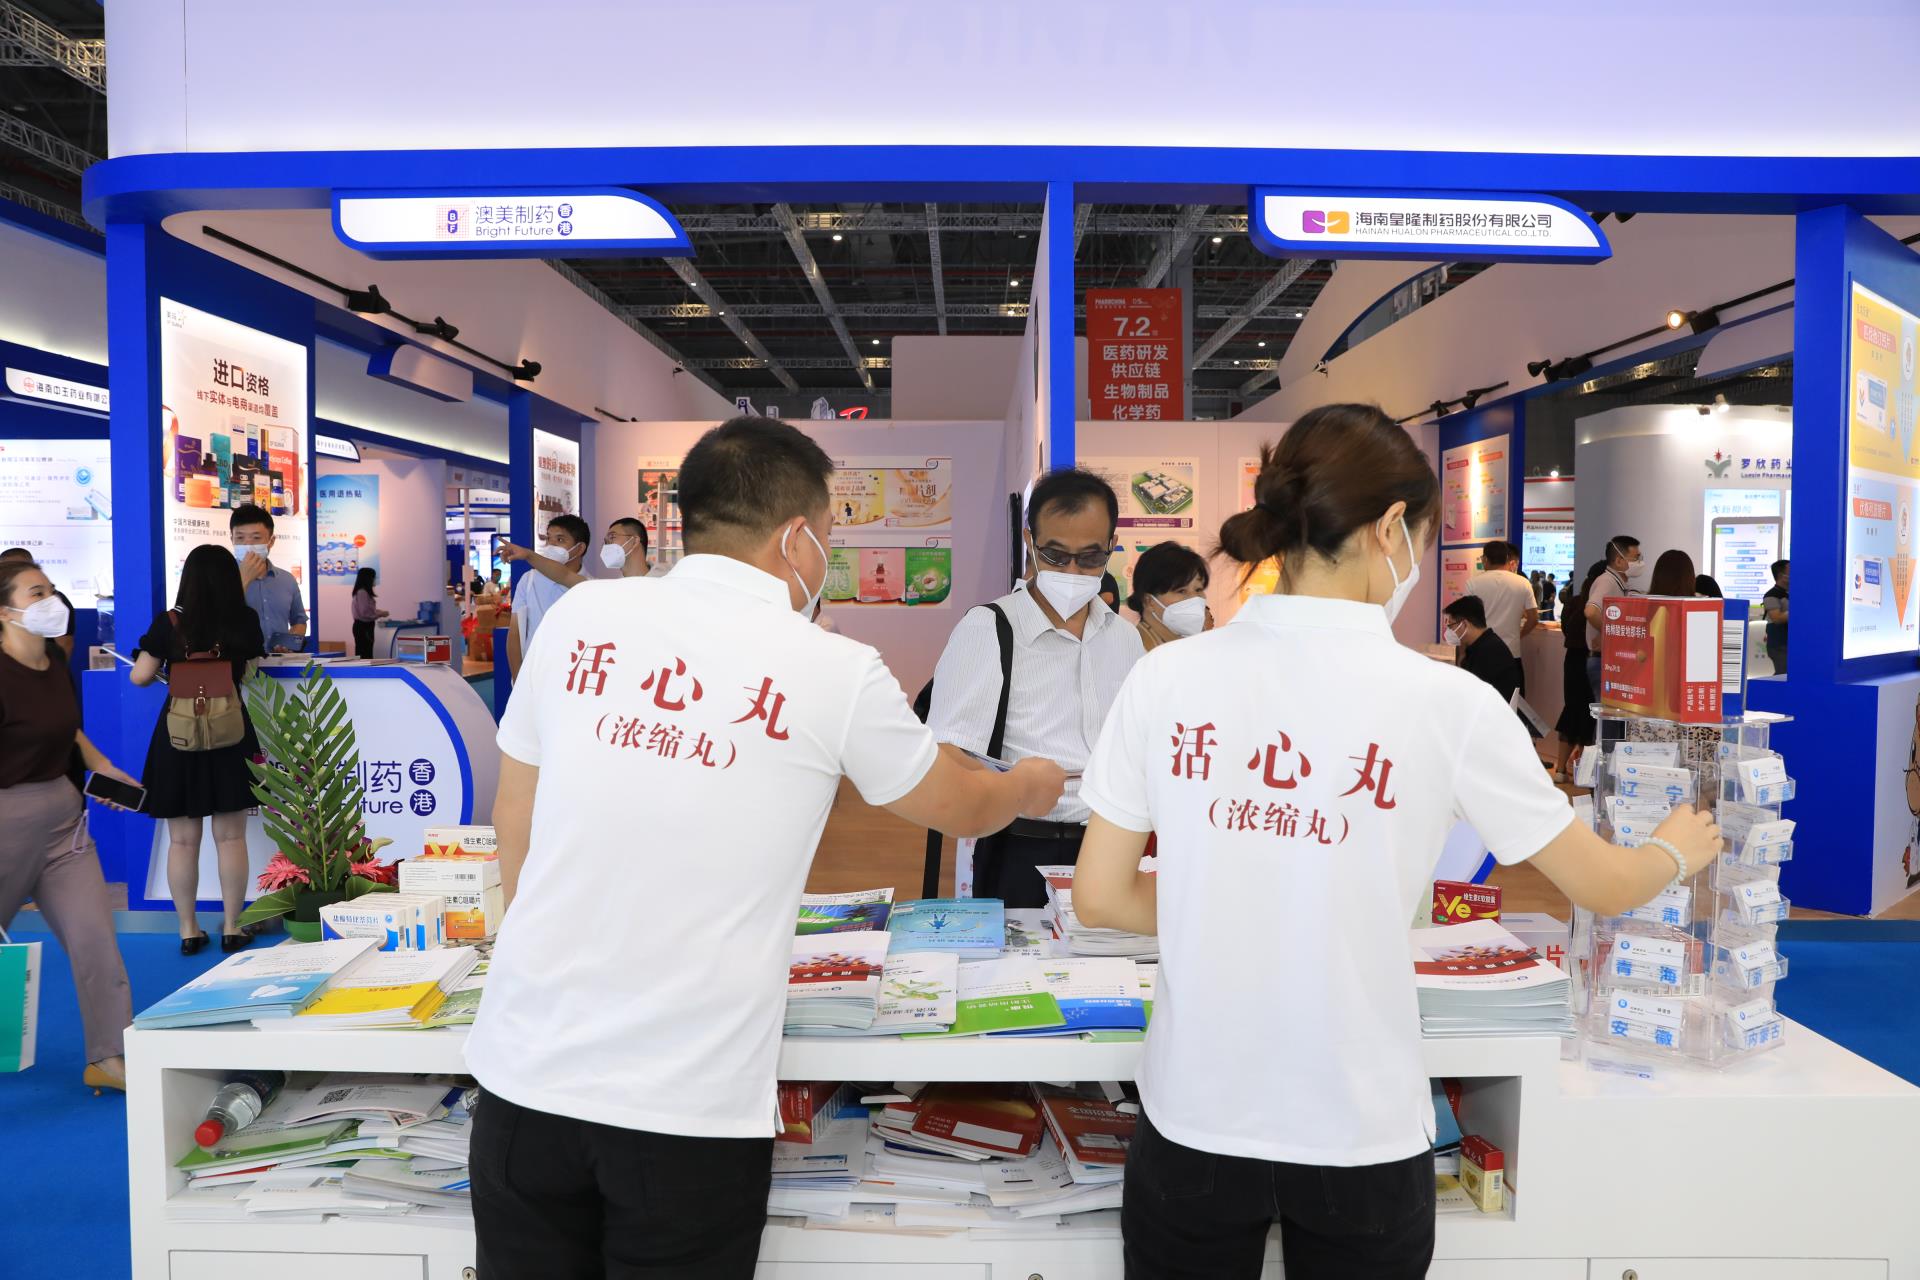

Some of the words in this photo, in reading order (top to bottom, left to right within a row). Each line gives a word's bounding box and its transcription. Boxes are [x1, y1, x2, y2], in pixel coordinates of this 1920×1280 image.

[475, 205, 554, 224] 澳美制药
[1355, 211, 1552, 229] 海南皇隆制药股份有限公司
[475, 227, 510, 239] Bright
[515, 226, 554, 236] Future
[1355, 228, 1390, 236] HAINAN
[1391, 228, 1429, 236] HUALON
[1430, 228, 1514, 237] PHARMACEUTICAL
[1113, 317, 1151, 337] 7.2
[1103, 345, 1169, 361] 医药研发
[213, 358, 270, 397] 进口资格
[1111, 362, 1161, 379] 供应链
[1103, 383, 1169, 399] 生物制品
[1112, 404, 1161, 420] 化学药
[566, 639, 790, 741] 活心丸
[596, 713, 737, 770] (浓缩丸)
[1170, 722, 1397, 810] 活心丸
[1208, 797, 1349, 845] (浓缩丸)
[1437, 893, 1472, 919] Ve
